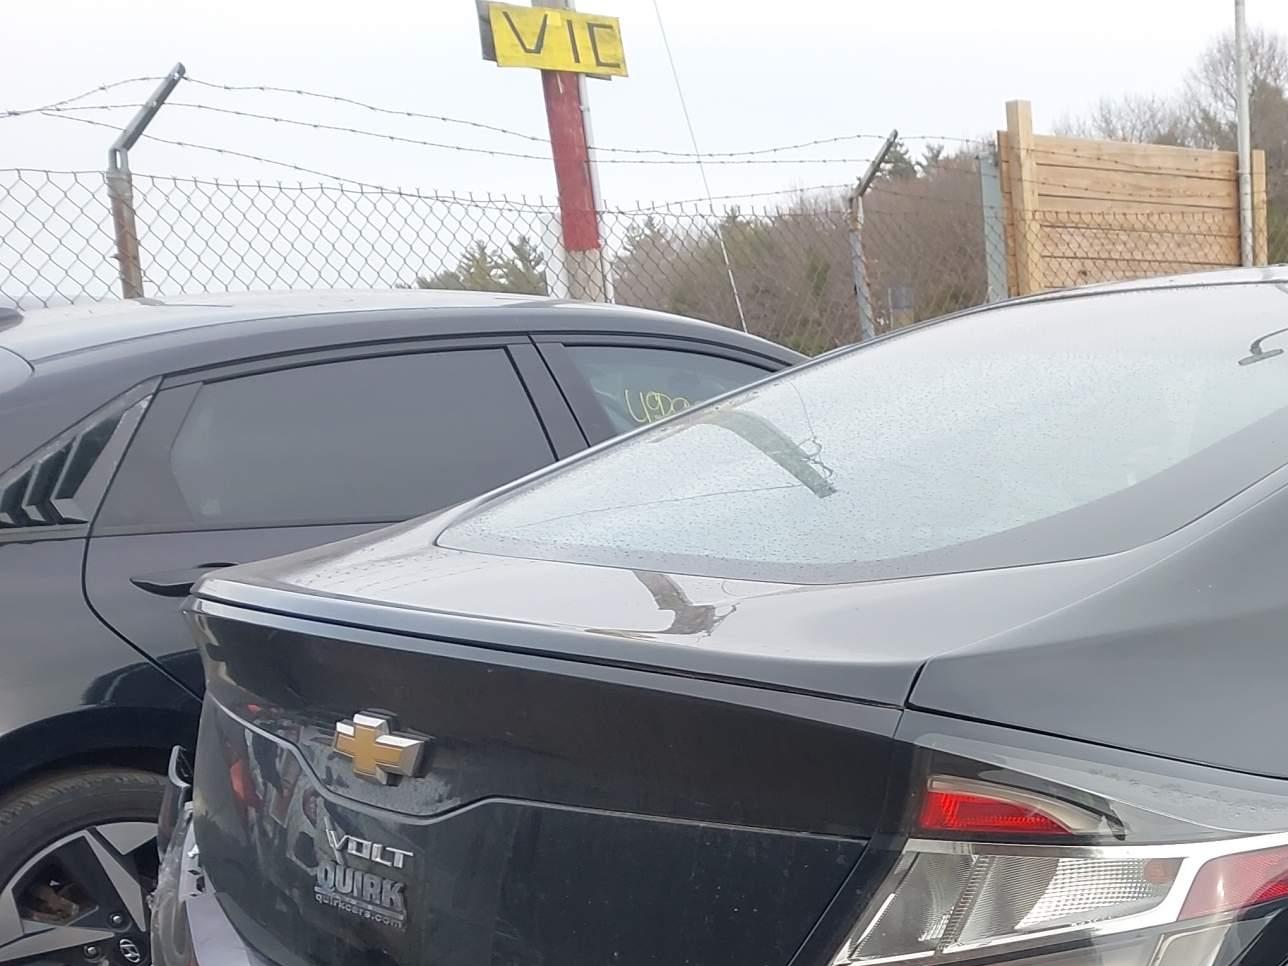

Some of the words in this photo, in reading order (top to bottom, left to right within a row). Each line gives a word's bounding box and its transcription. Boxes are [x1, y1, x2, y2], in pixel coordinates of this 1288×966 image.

[502, 11, 621, 68] VIC
[326, 829, 414, 869] VOLT
[317, 861, 405, 912] QUIRK
[315, 894, 403, 930] quirkcars.com
